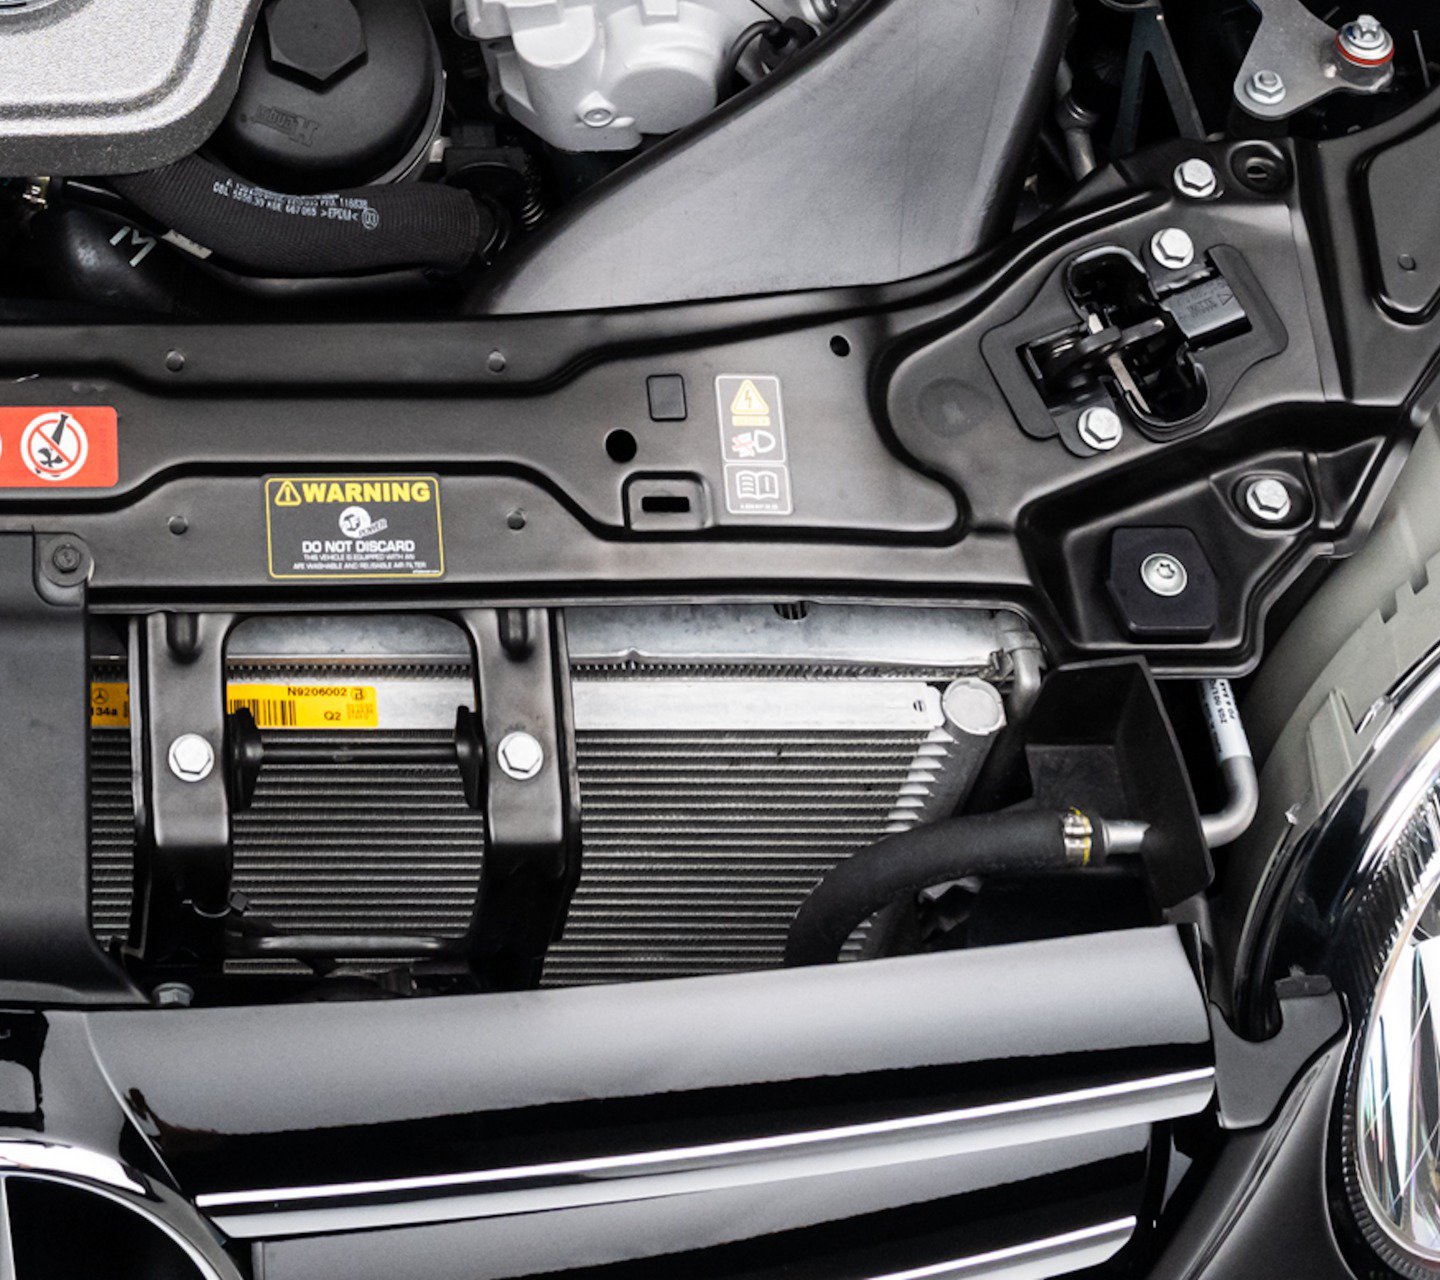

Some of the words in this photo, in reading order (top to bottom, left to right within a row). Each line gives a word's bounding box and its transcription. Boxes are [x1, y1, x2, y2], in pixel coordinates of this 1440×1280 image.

[302, 481, 431, 503] WARNING
[302, 541, 322, 553] DO
[325, 541, 353, 553] NOT
[356, 540, 415, 552] DISCARD
[304, 553, 318, 561] THIS
[320, 553, 344, 561] VEHICLE
[353, 553, 385, 561] EQUIPPED
[344, 562, 357, 570] AND
[324, 710, 342, 721] Q2
